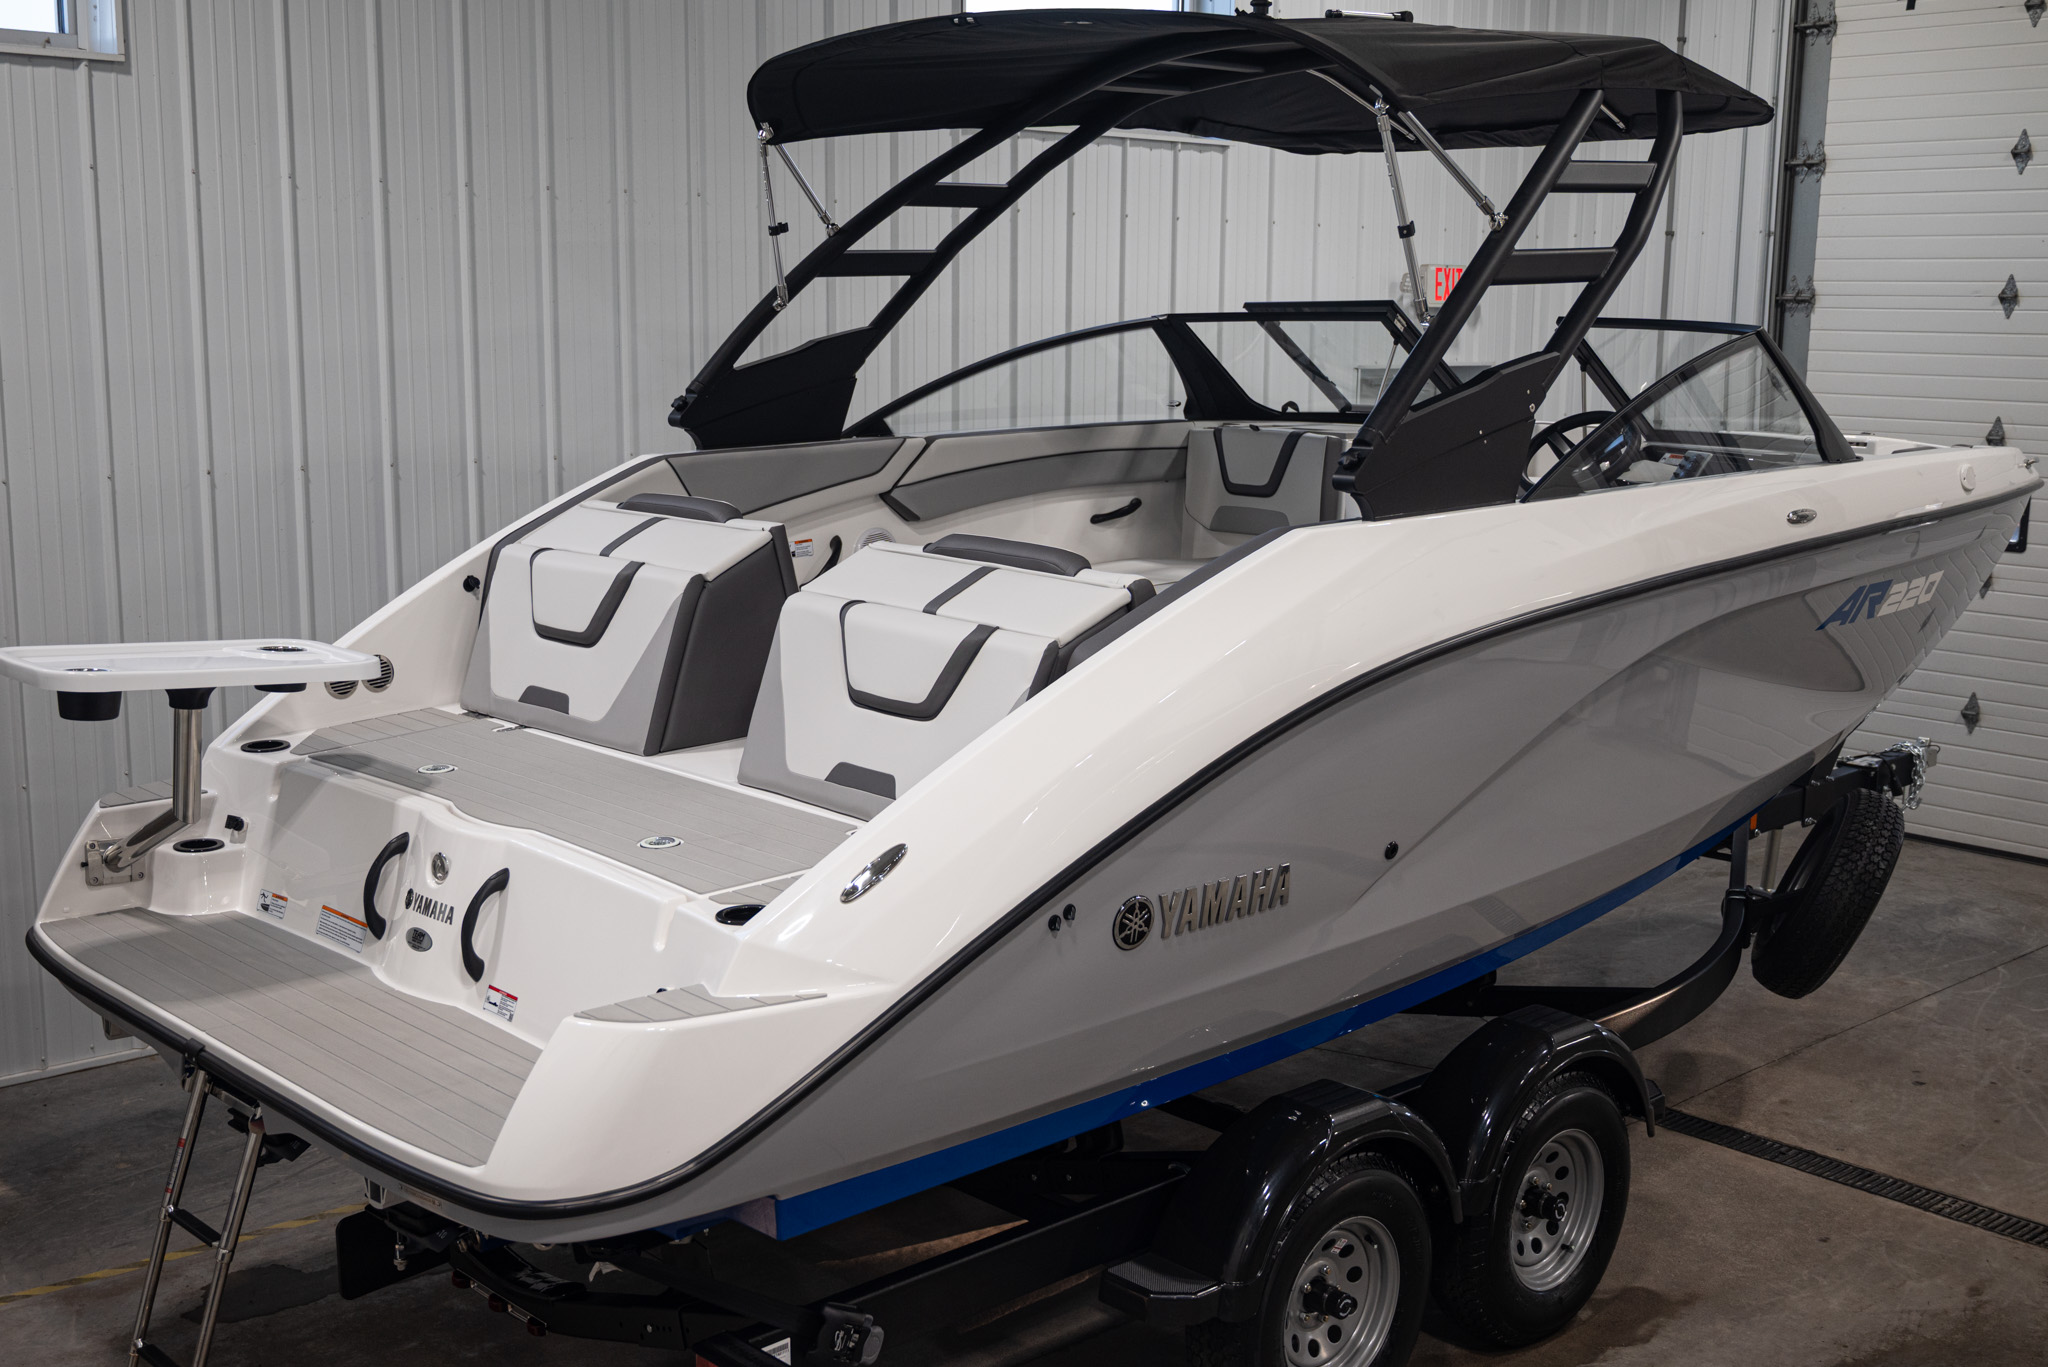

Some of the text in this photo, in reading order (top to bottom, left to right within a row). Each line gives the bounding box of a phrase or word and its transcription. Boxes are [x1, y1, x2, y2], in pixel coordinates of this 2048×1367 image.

[1815, 570, 1945, 631] AR220
[413, 892, 454, 925] YAMAHA
[1159, 862, 1291, 939] YAMAHA
